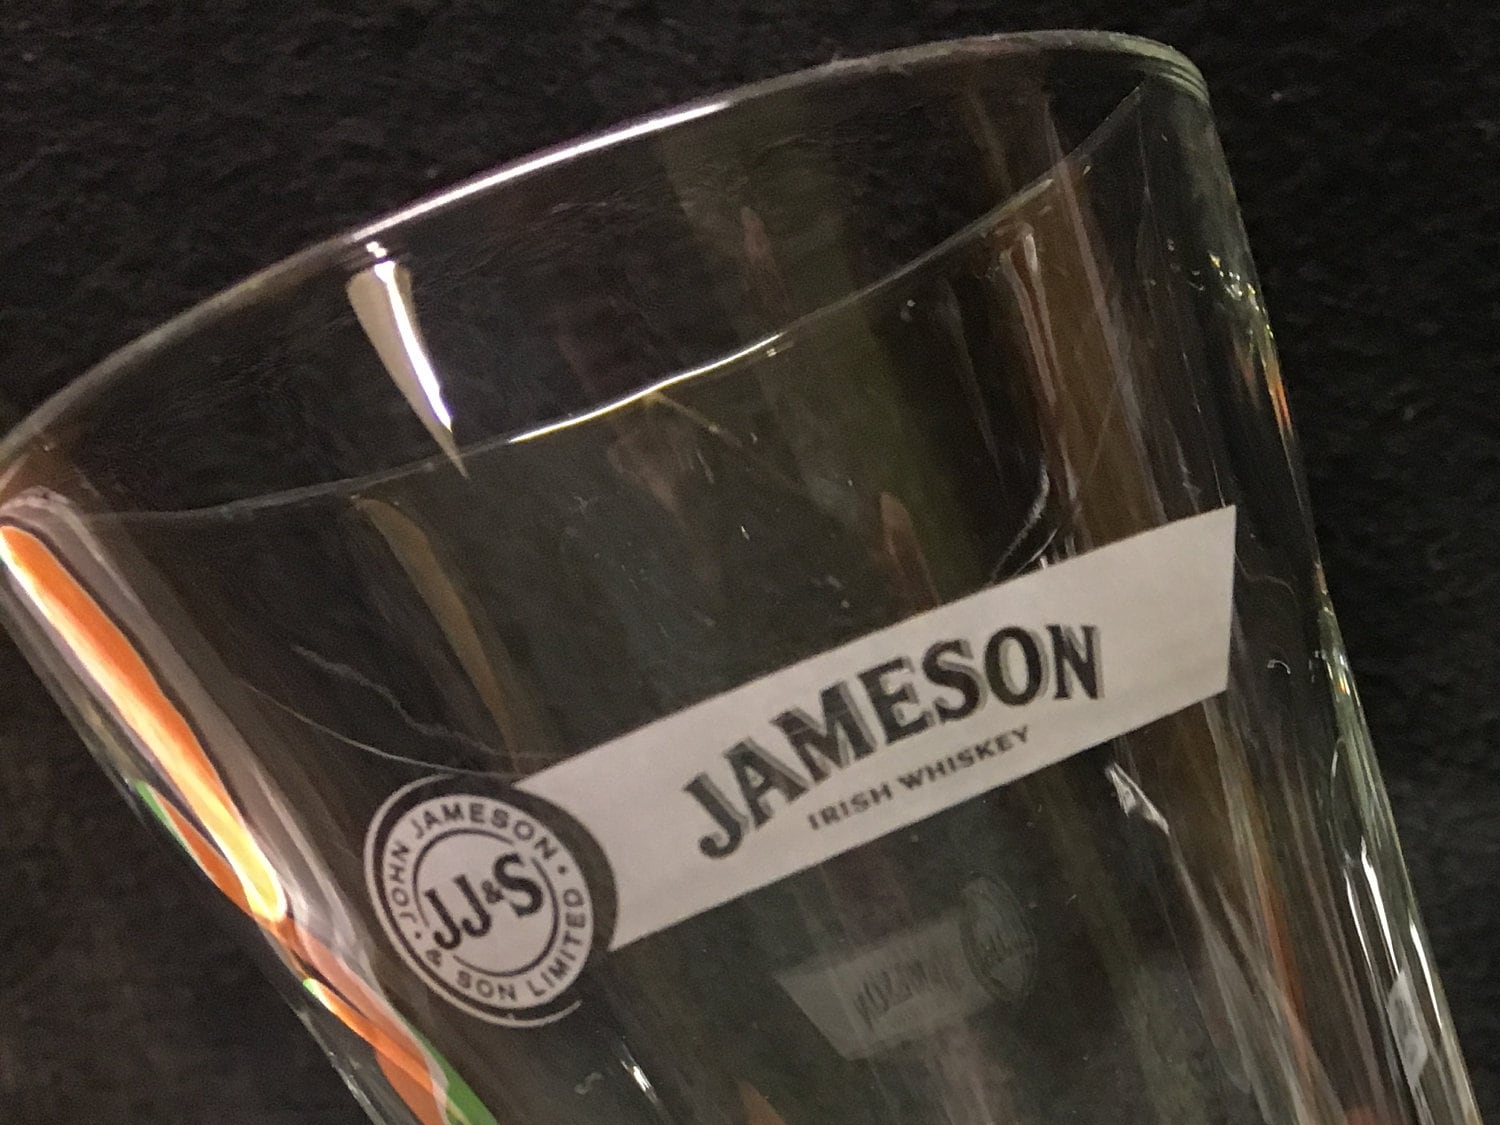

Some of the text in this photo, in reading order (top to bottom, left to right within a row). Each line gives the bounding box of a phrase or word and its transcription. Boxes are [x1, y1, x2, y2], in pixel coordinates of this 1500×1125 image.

[683, 623, 1106, 860] JAMESON
[808, 724, 1031, 831] IRISH WHISKEY
[389, 802, 557, 924] JOHN JAMESON
[424, 853, 544, 950] JJ&S
[456, 969, 517, 1001] SON
[527, 888, 586, 998] LIMITED
